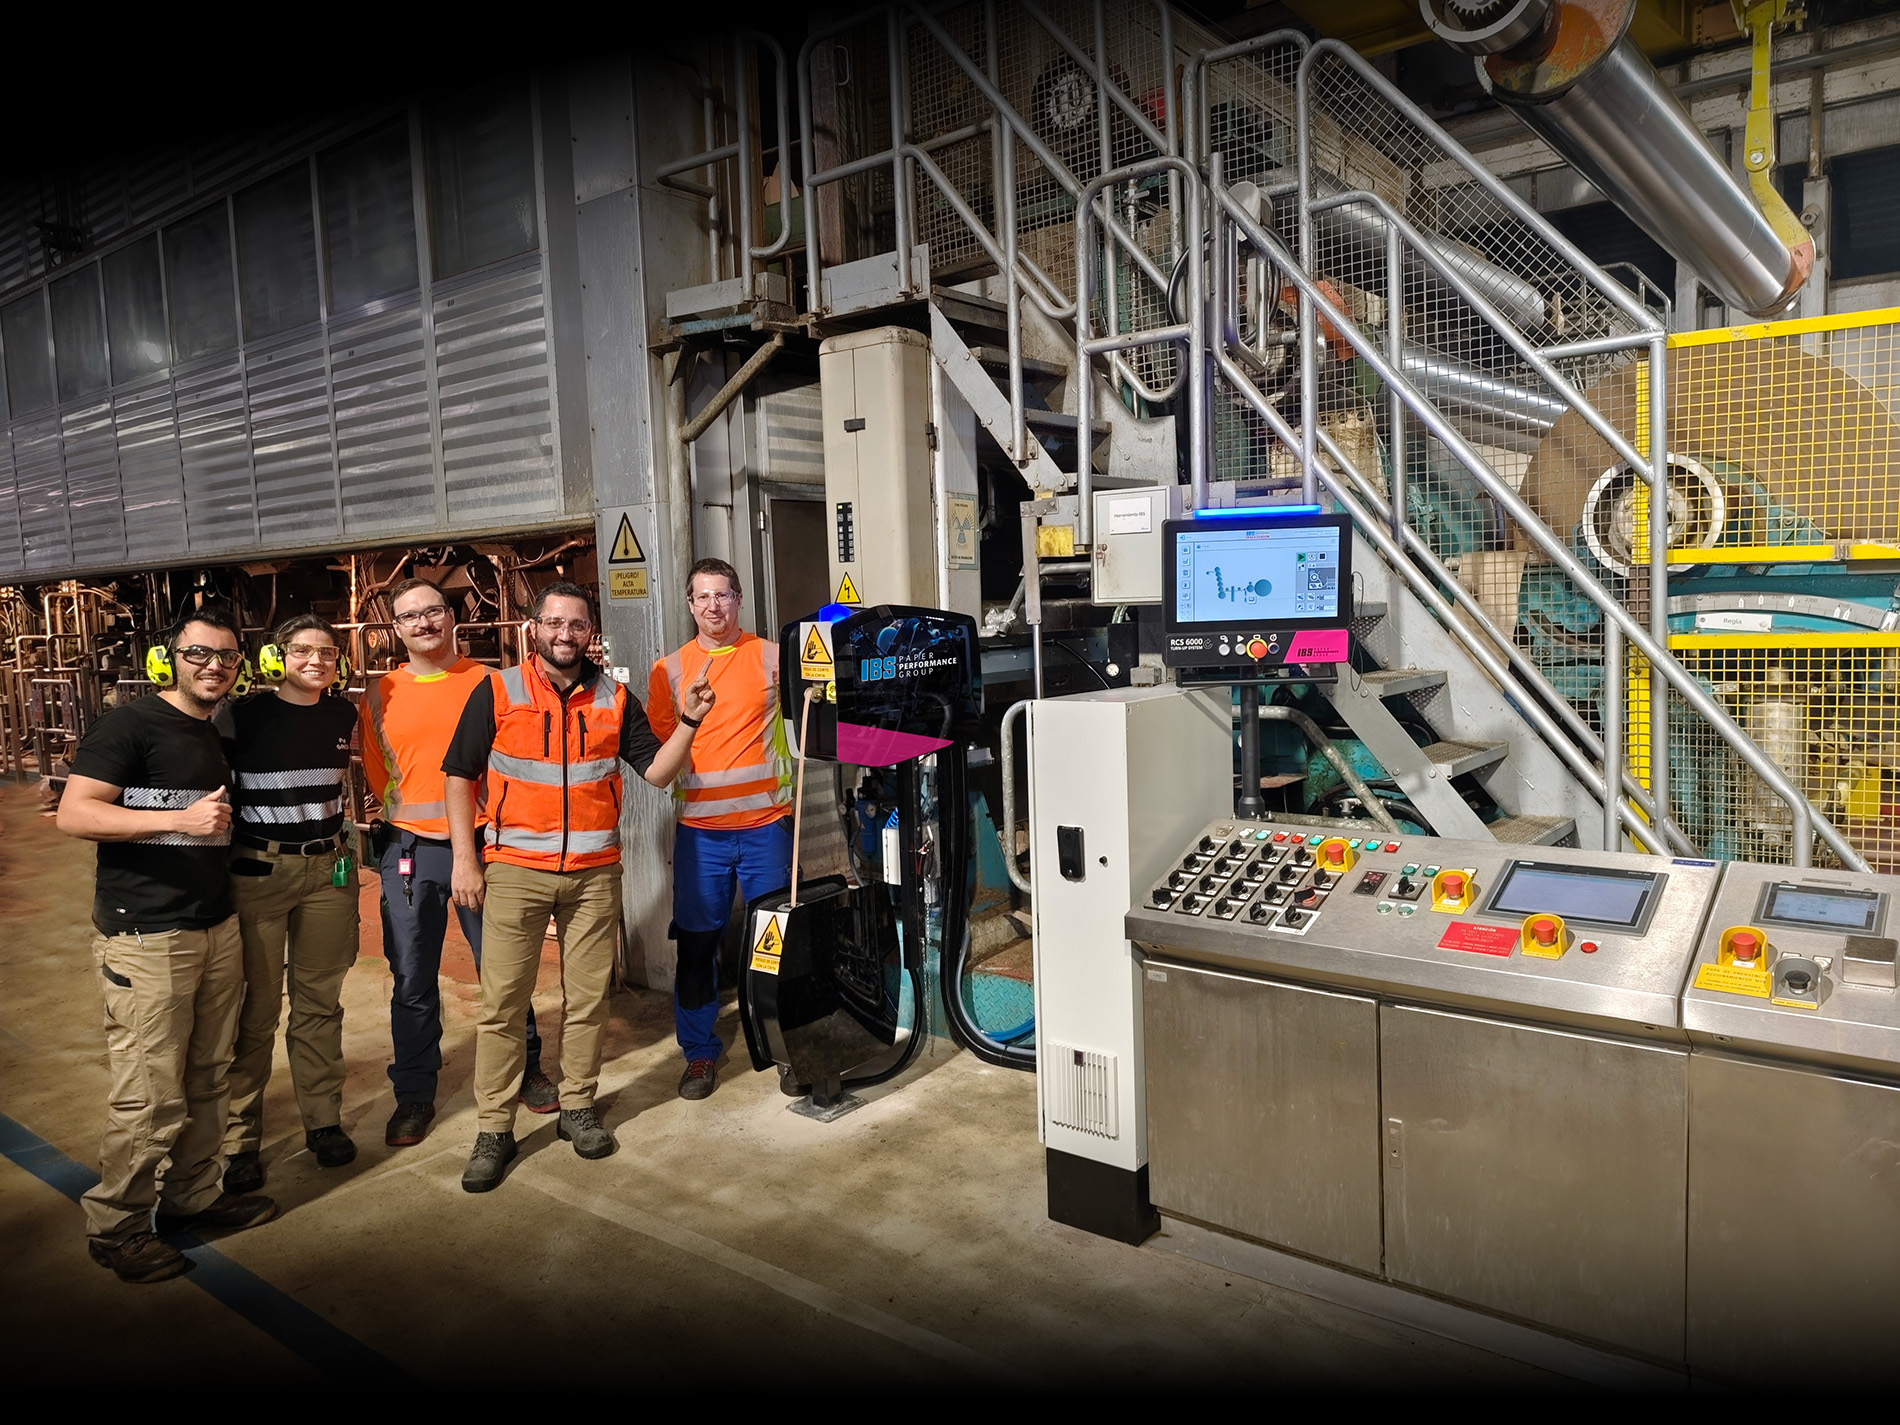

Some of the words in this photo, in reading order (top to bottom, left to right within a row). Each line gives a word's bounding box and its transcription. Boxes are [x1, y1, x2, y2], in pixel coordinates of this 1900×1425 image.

[615, 571, 640, 580] ¡PELIGRO!
[1723, 617, 1743, 625] Regla
[1185, 638, 1203, 646] 6000
[898, 652, 934, 663] PAPER
[1297, 648, 1313, 657] IBS
[898, 657, 957, 670] PERFORMANCE
[861, 656, 896, 682] IBS
[898, 668, 934, 679] GROUP
